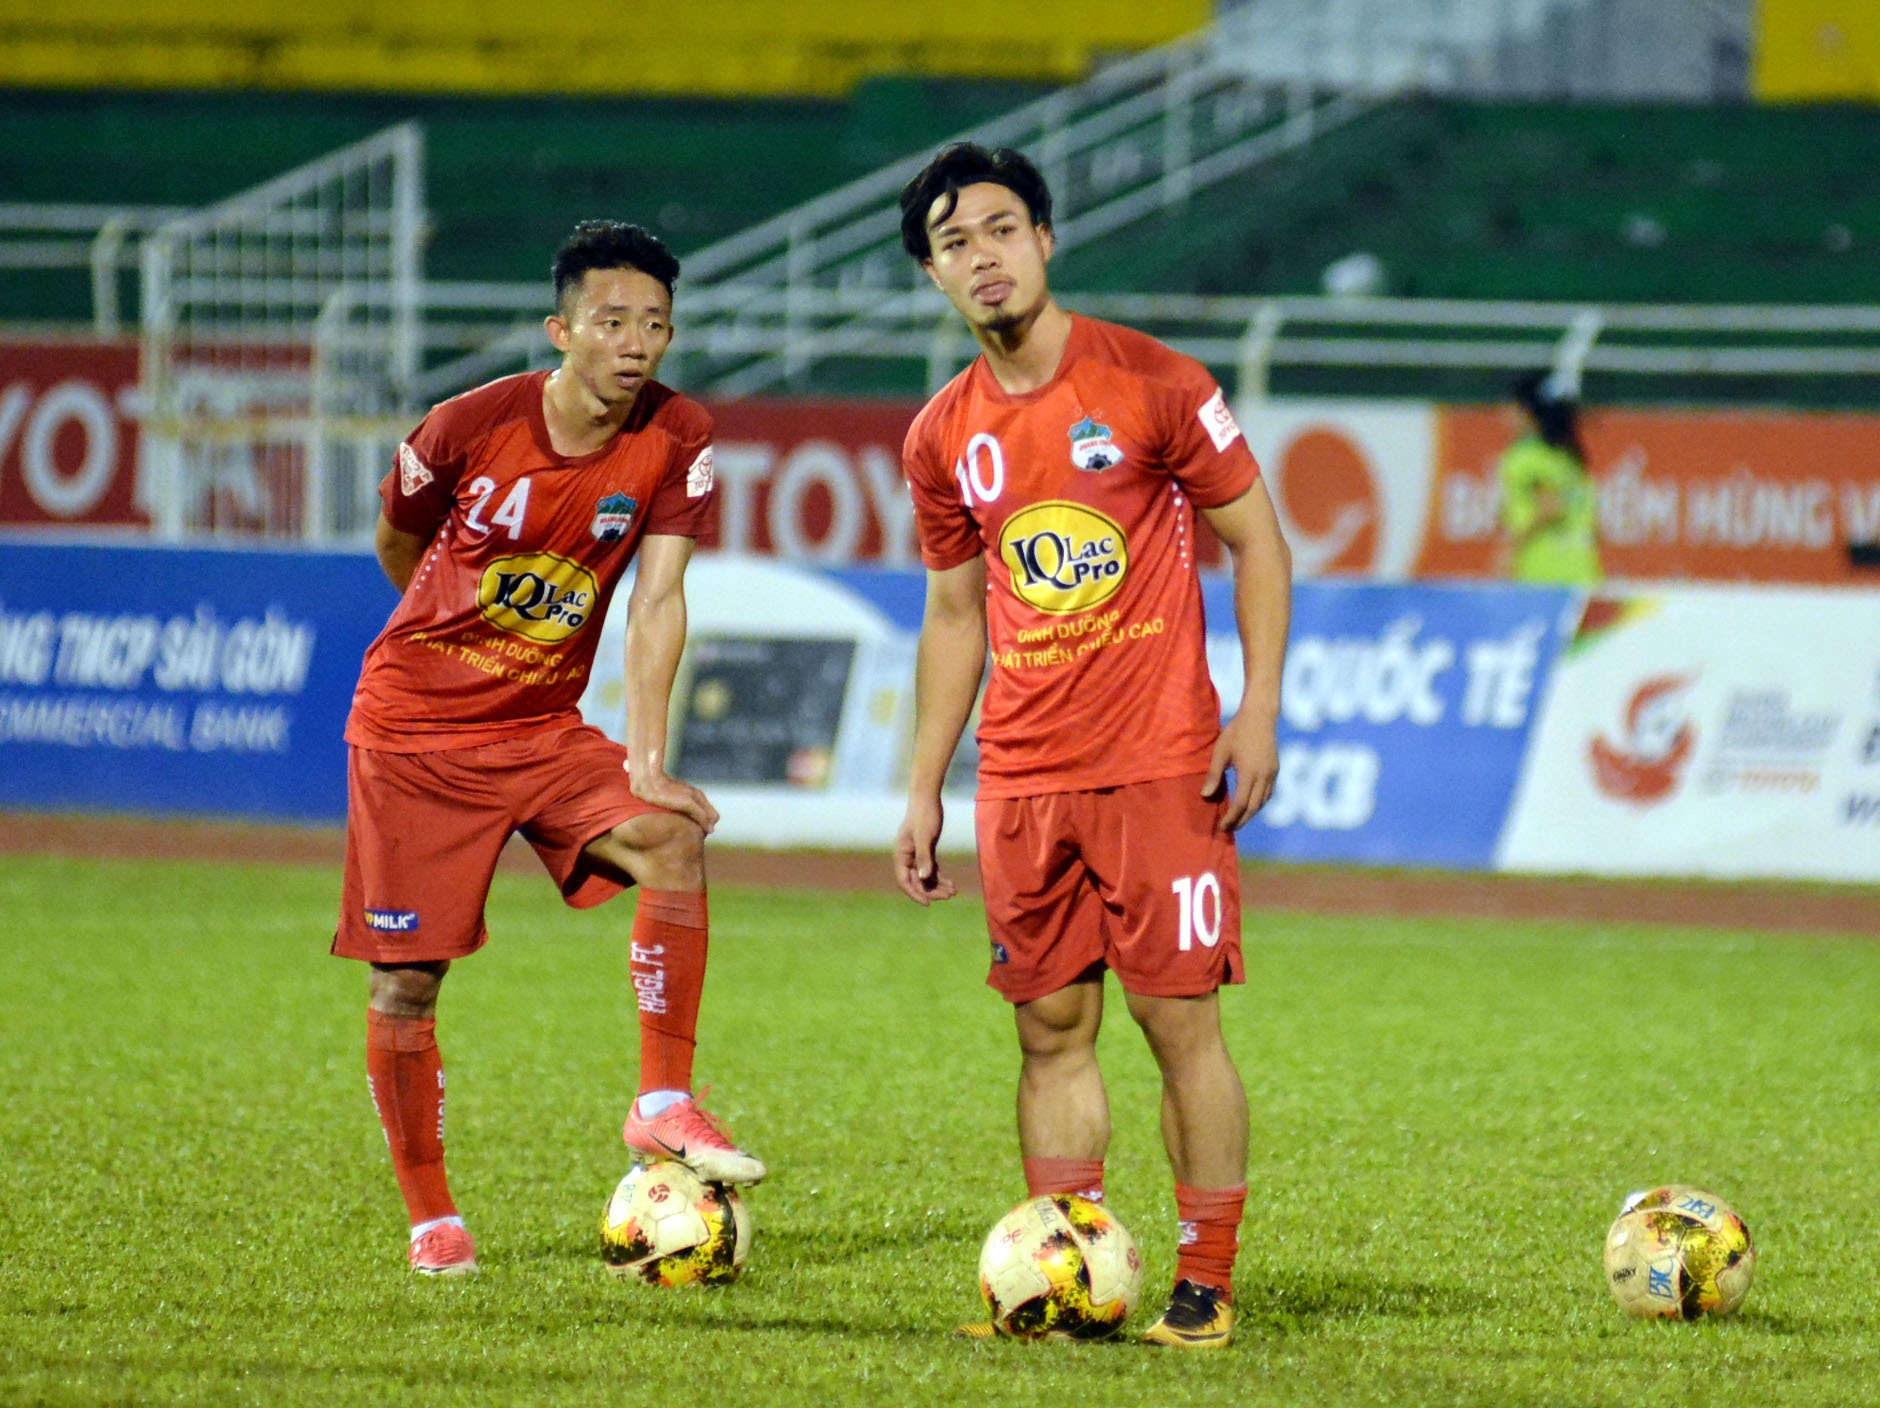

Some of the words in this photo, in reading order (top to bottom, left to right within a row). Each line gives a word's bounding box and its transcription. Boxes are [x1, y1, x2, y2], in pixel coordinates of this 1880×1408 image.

[955, 432, 1004, 509] 10
[465, 476, 532, 541] 24
[1010, 531, 1080, 591] IQ
[1064, 536, 1115, 564] Lac
[1071, 561, 1121, 586] Pro
[495, 572, 548, 621] IQ
[543, 583, 587, 608] Lac
[544, 604, 585, 628] Pro
[1128, 617, 1165, 640] CAO
[1281, 612, 1455, 733] QUỐC
[189, 700, 288, 752] BANK
[1171, 872, 1222, 951] 10
[630, 941, 665, 968] FC
[632, 970, 667, 1015] HAGL
